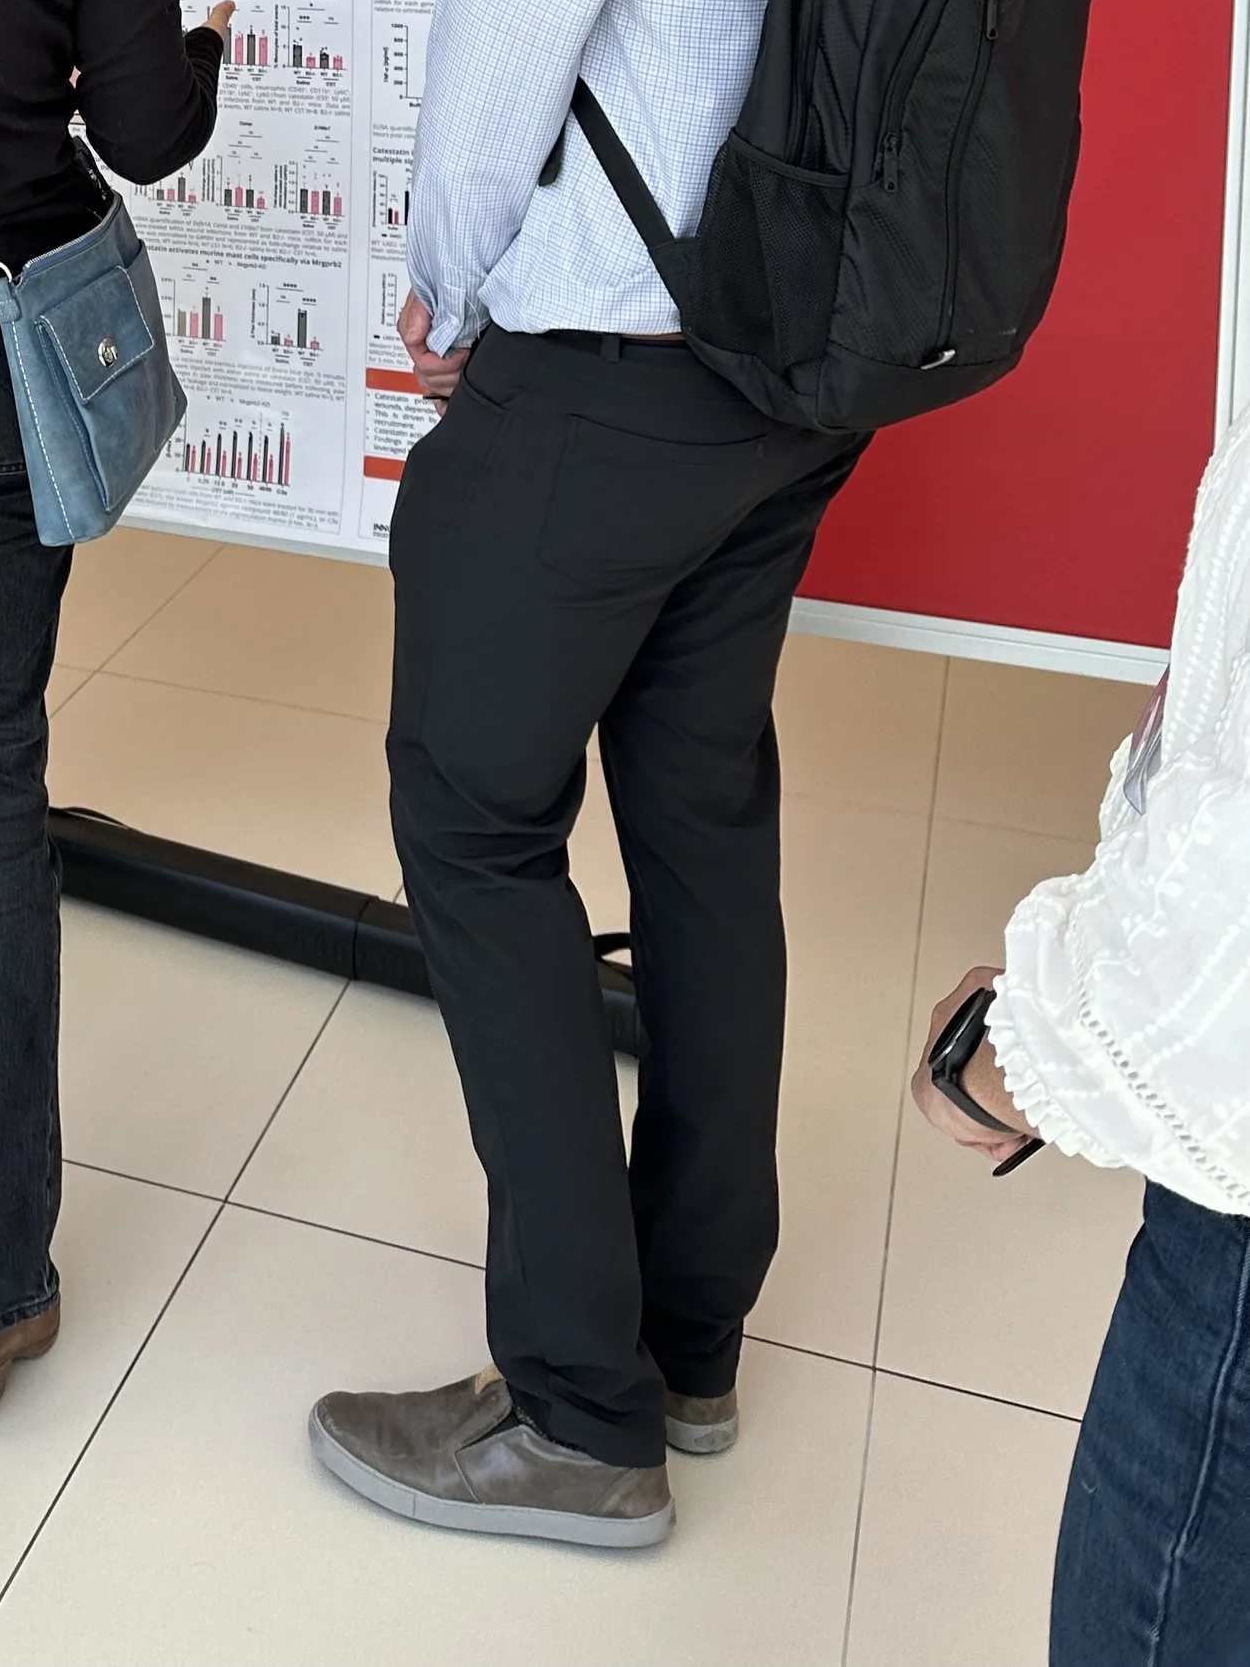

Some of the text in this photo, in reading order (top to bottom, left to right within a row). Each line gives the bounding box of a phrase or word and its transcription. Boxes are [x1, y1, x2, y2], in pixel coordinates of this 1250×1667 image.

[372, 147, 410, 156] Catestatin
[168, 246, 199, 255] activates
[374, 393, 409, 403] Catestatin
[374, 409, 389, 418] This
